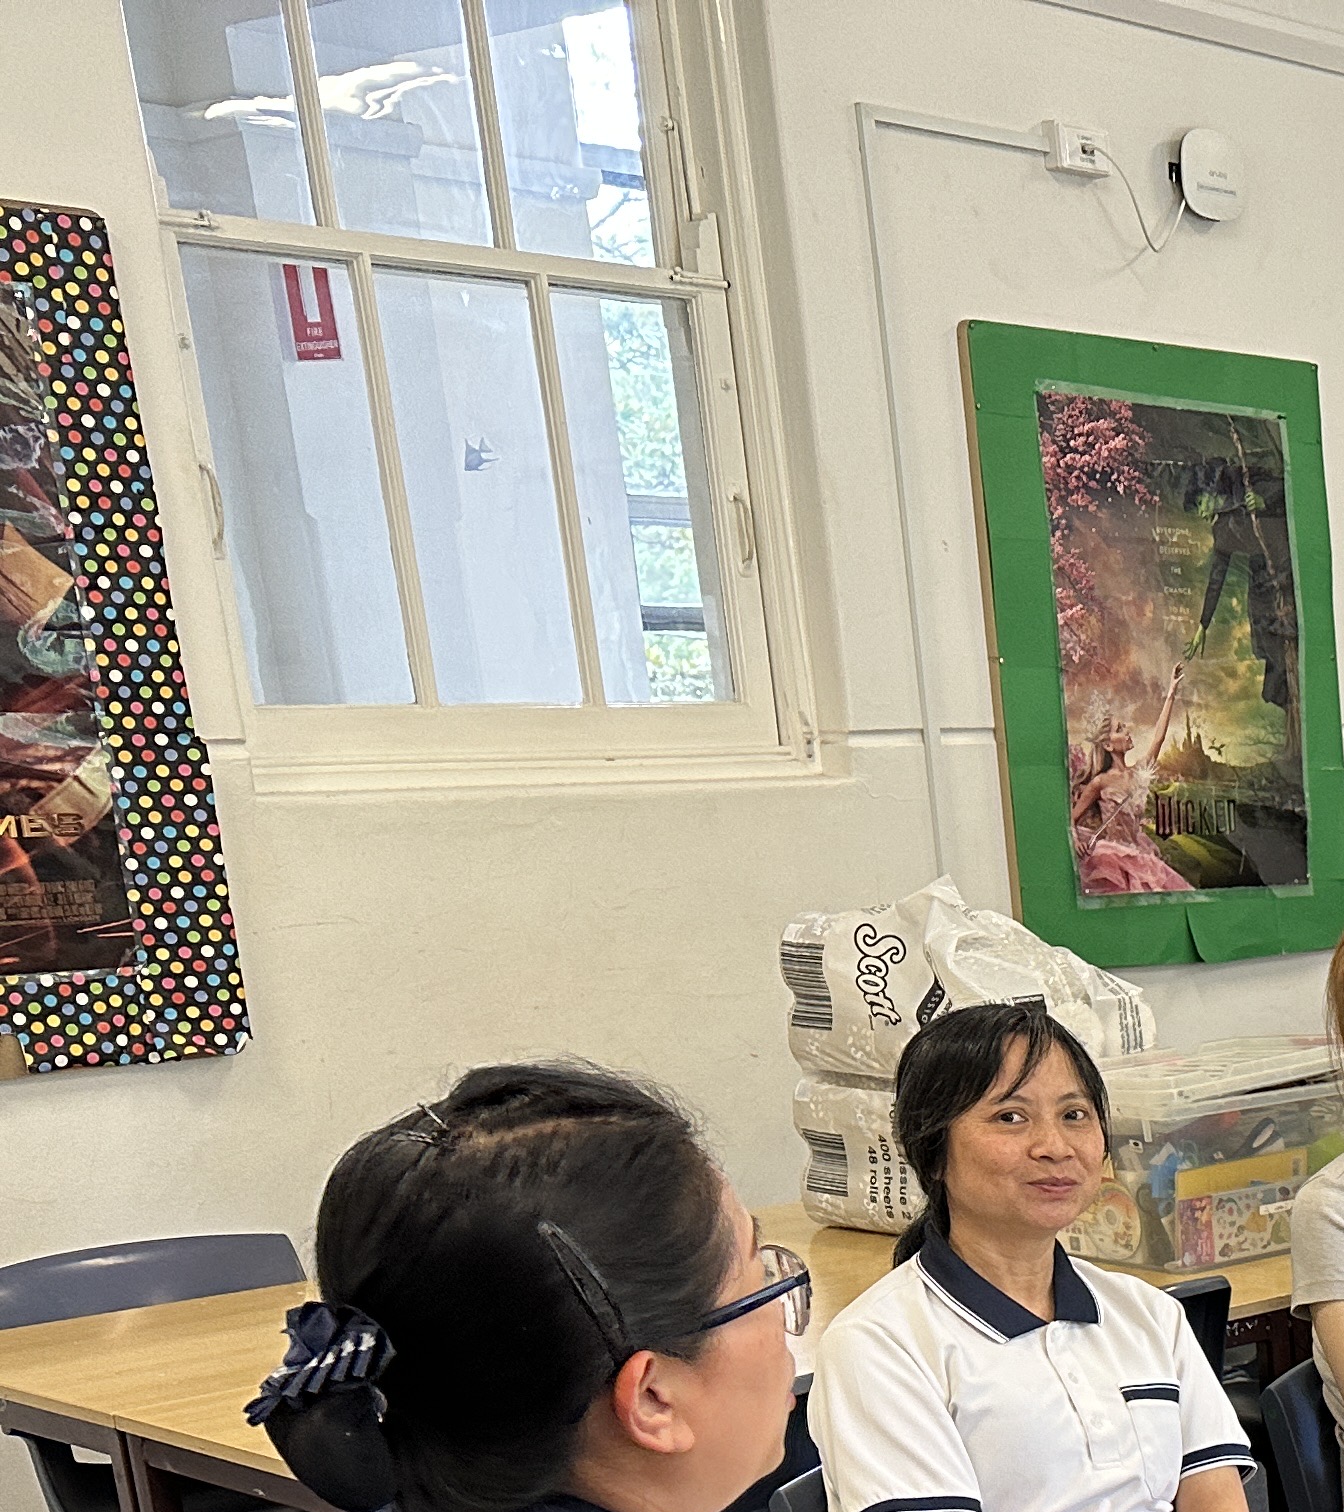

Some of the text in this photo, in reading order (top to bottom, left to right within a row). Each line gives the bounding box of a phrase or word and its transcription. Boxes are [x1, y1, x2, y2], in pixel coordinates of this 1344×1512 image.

[854, 922, 907, 1027] Scott
[868, 1145, 879, 1204] 48 rolls
[878, 1133, 895, 1219] 400 sheets
